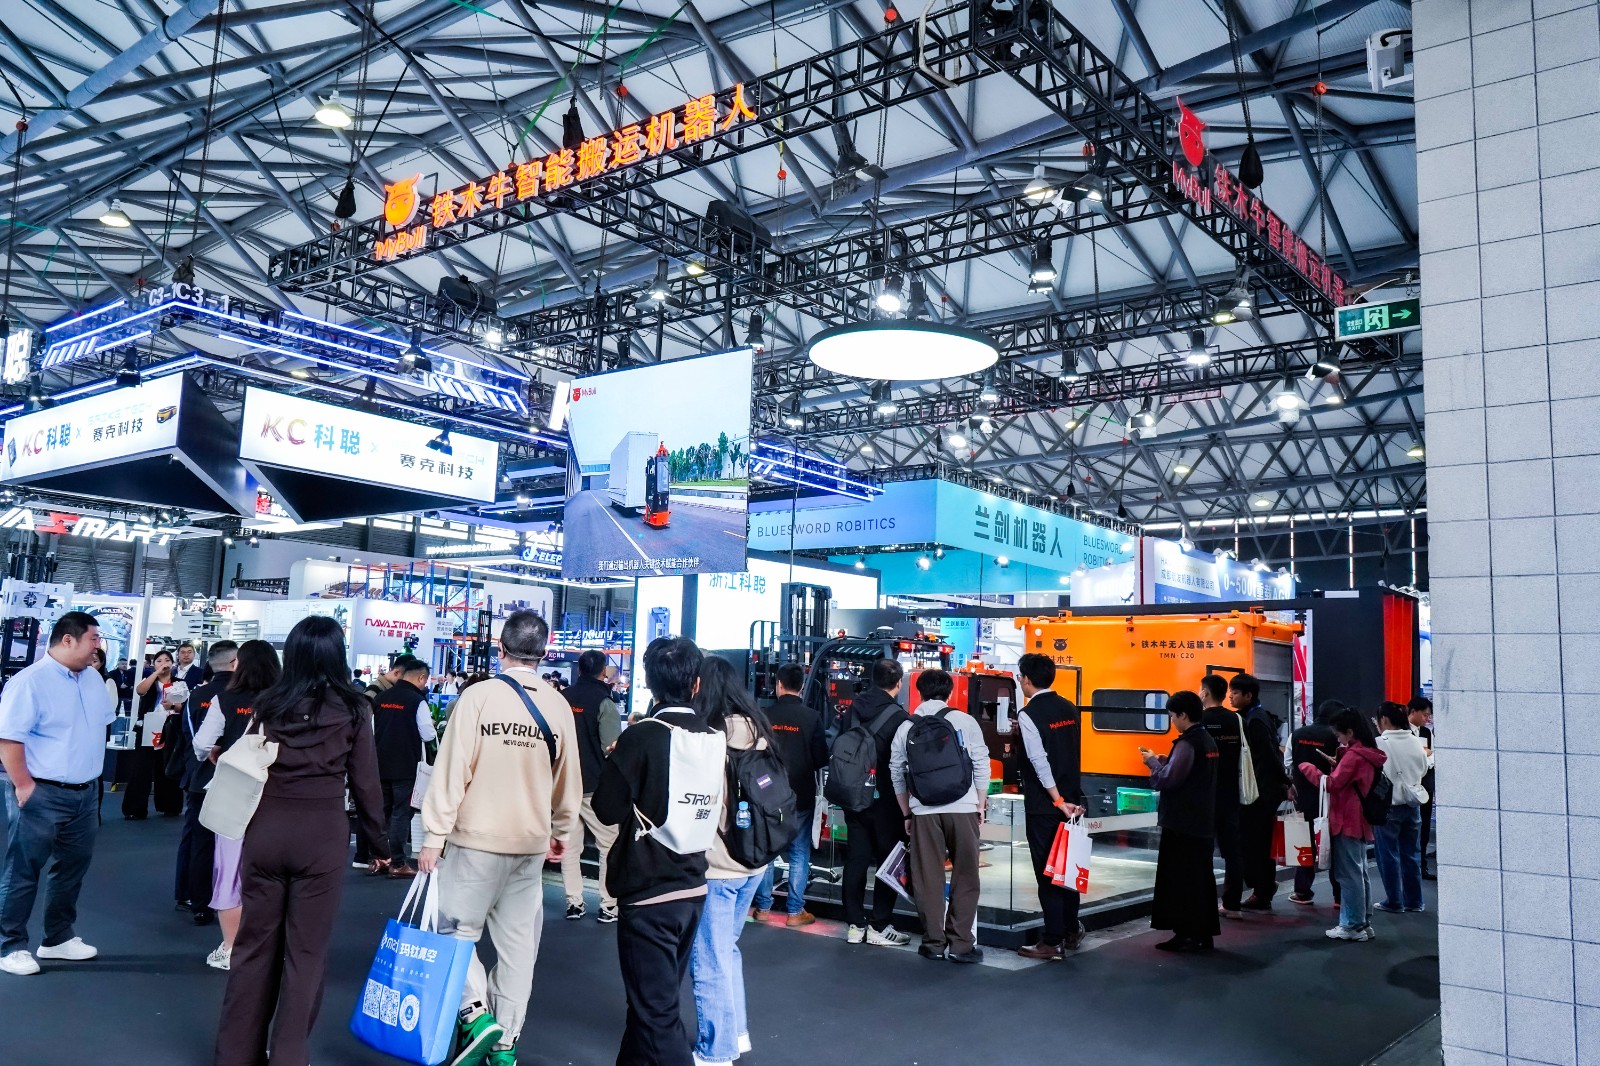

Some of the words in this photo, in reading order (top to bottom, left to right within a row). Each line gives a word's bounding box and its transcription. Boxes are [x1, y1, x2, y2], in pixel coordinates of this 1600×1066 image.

[431, 83, 757, 228] 铁木牛智能搬运机器人
[1172, 161, 1211, 215] MyBull
[375, 225, 427, 261] MyBull
[176, 282, 230, 314] C3-1
[93, 418, 143, 442] 赛克科技
[400, 453, 474, 481] 赛克科技
[757, 522, 831, 537] BLUESWORD
[836, 517, 896, 533] ROBITICS
[974, 504, 1063, 558] 兰剑机器人
[1083, 534, 1124, 555] BLUESWORD
[709, 571, 766, 594] 浙江科聪
[1141, 640, 1215, 650] 铁木牛无人运输车
